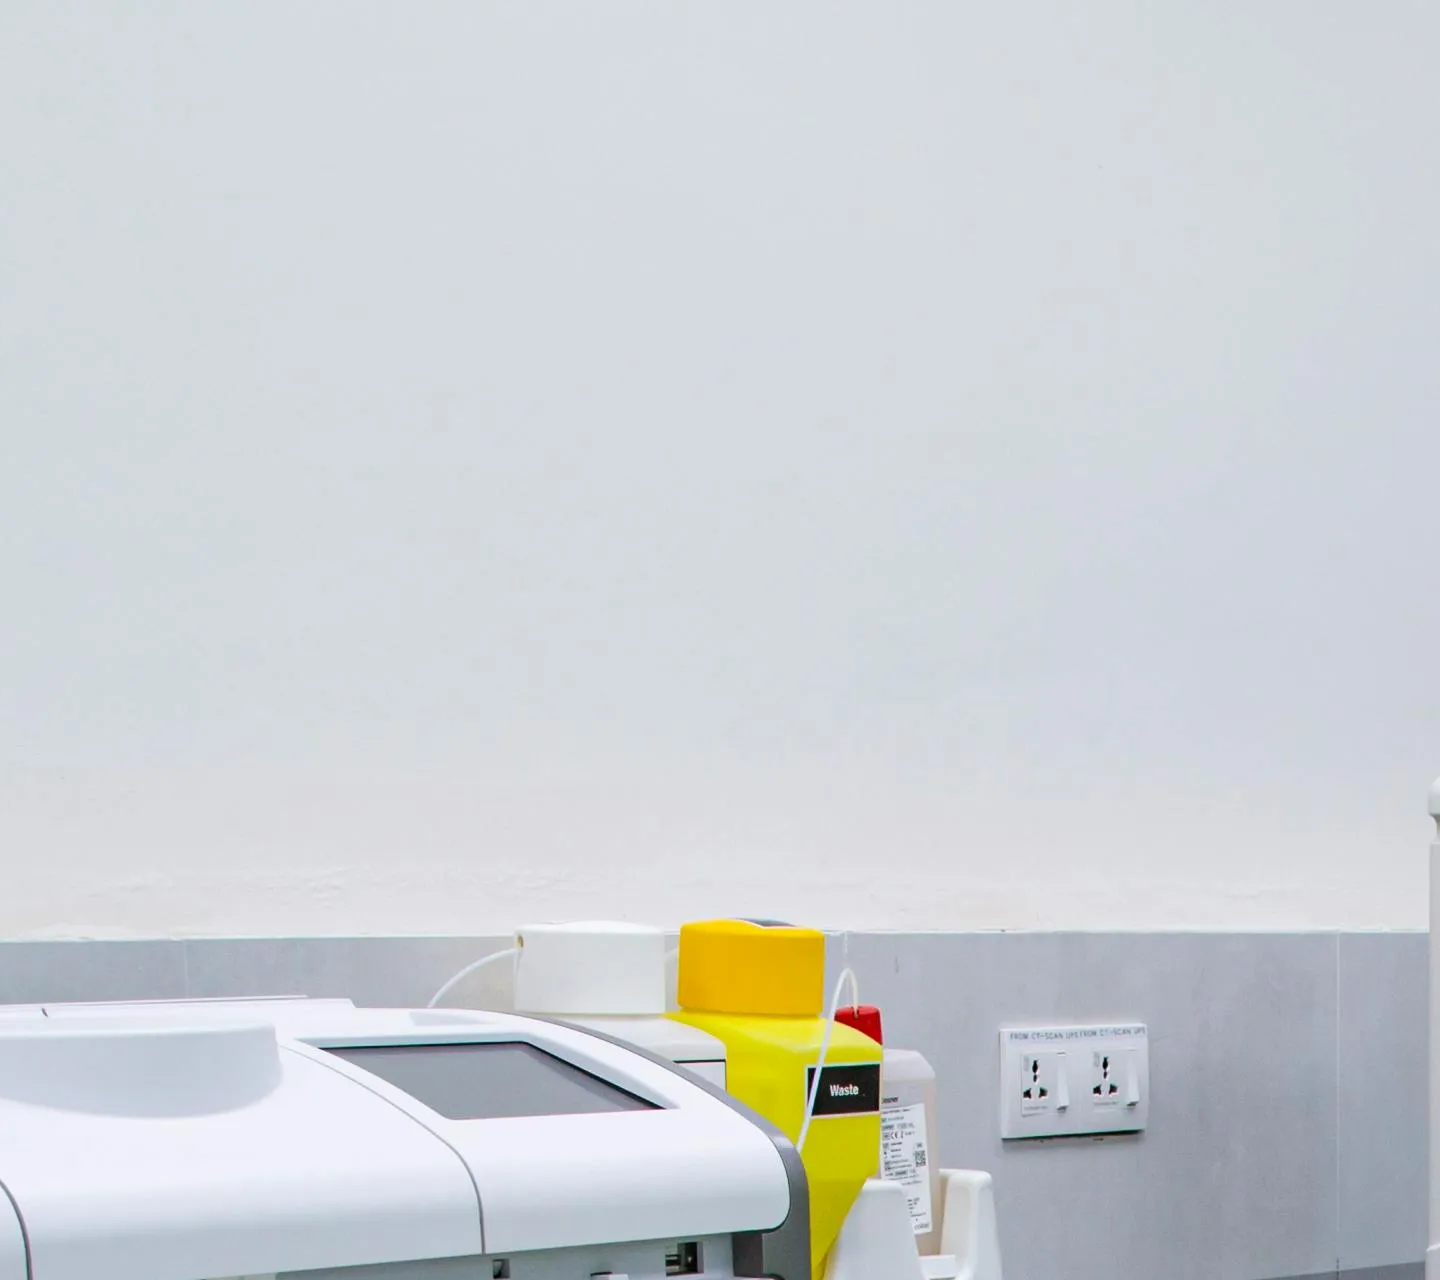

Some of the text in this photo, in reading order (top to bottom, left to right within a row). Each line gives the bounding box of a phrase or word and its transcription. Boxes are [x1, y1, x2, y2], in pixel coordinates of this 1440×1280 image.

[1010, 1031, 1028, 1040] FROM
[1031, 1031, 1063, 1040] CT-SCAN
[829, 1084, 859, 1097] Waste
